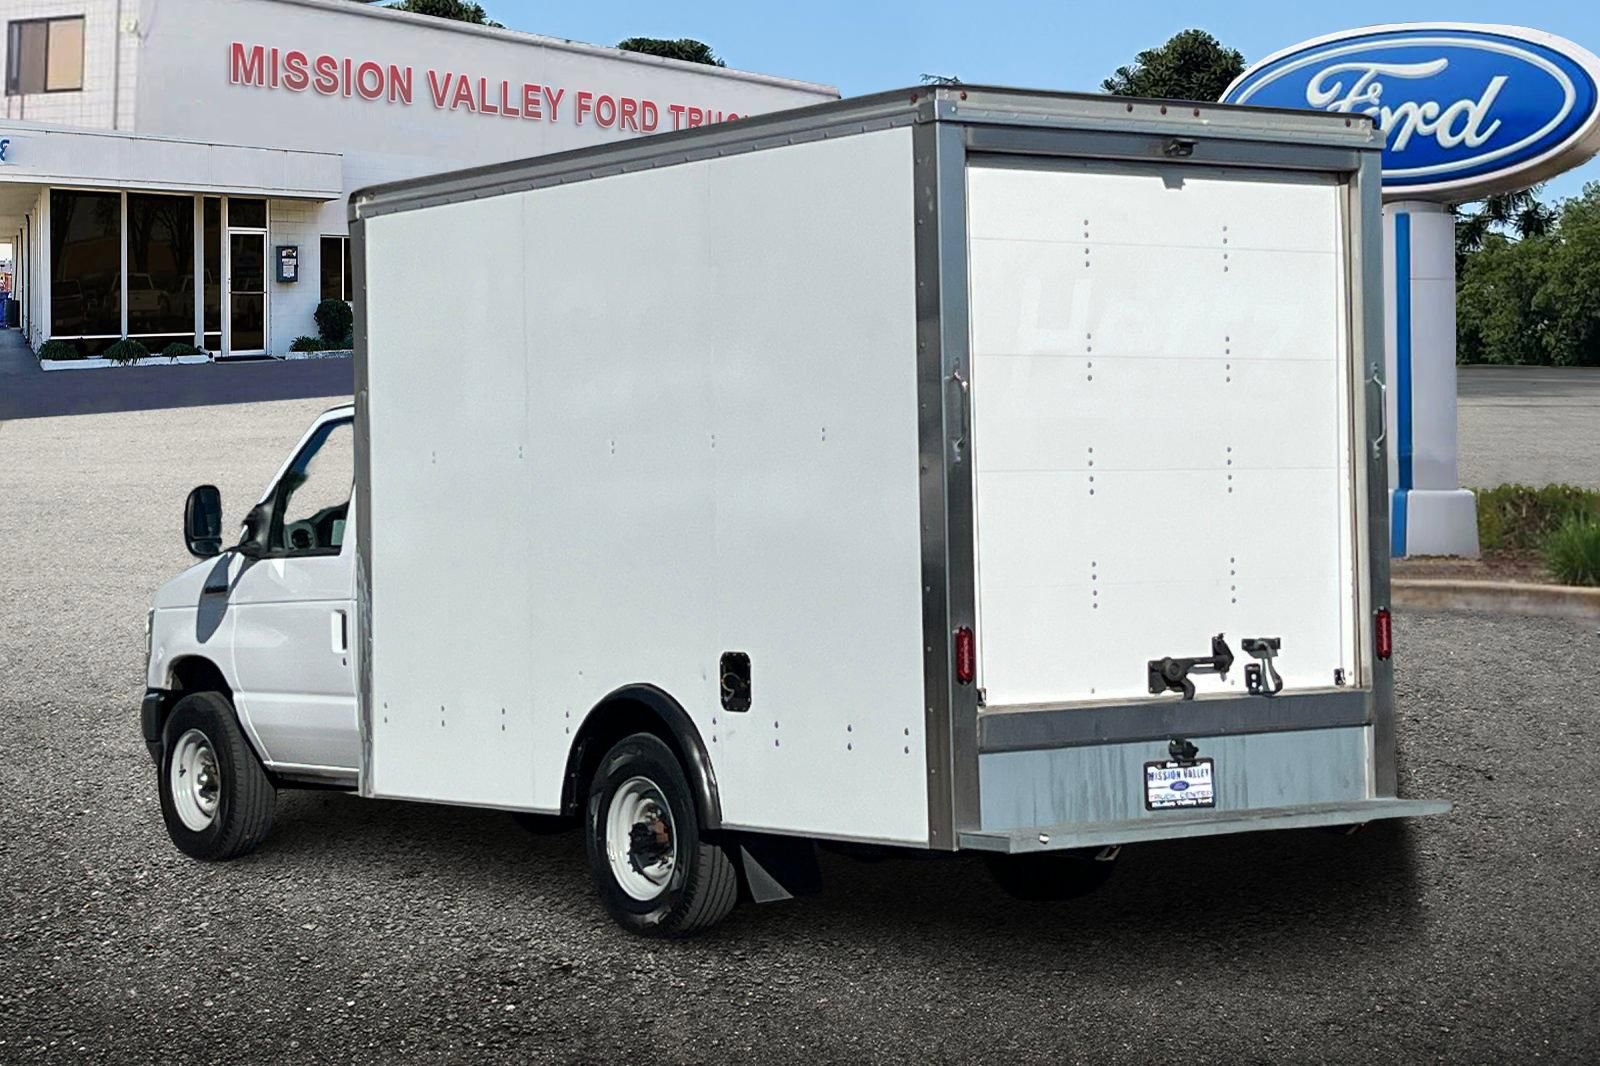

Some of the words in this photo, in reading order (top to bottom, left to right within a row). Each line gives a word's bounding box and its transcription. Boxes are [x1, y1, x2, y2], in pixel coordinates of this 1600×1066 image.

[230, 41, 413, 104] MISSION
[427, 69, 565, 121] VALLEY
[576, 91, 659, 133] FORD
[1147, 770, 1181, 782] MISSION
[1183, 768, 1209, 779] VALLEY
